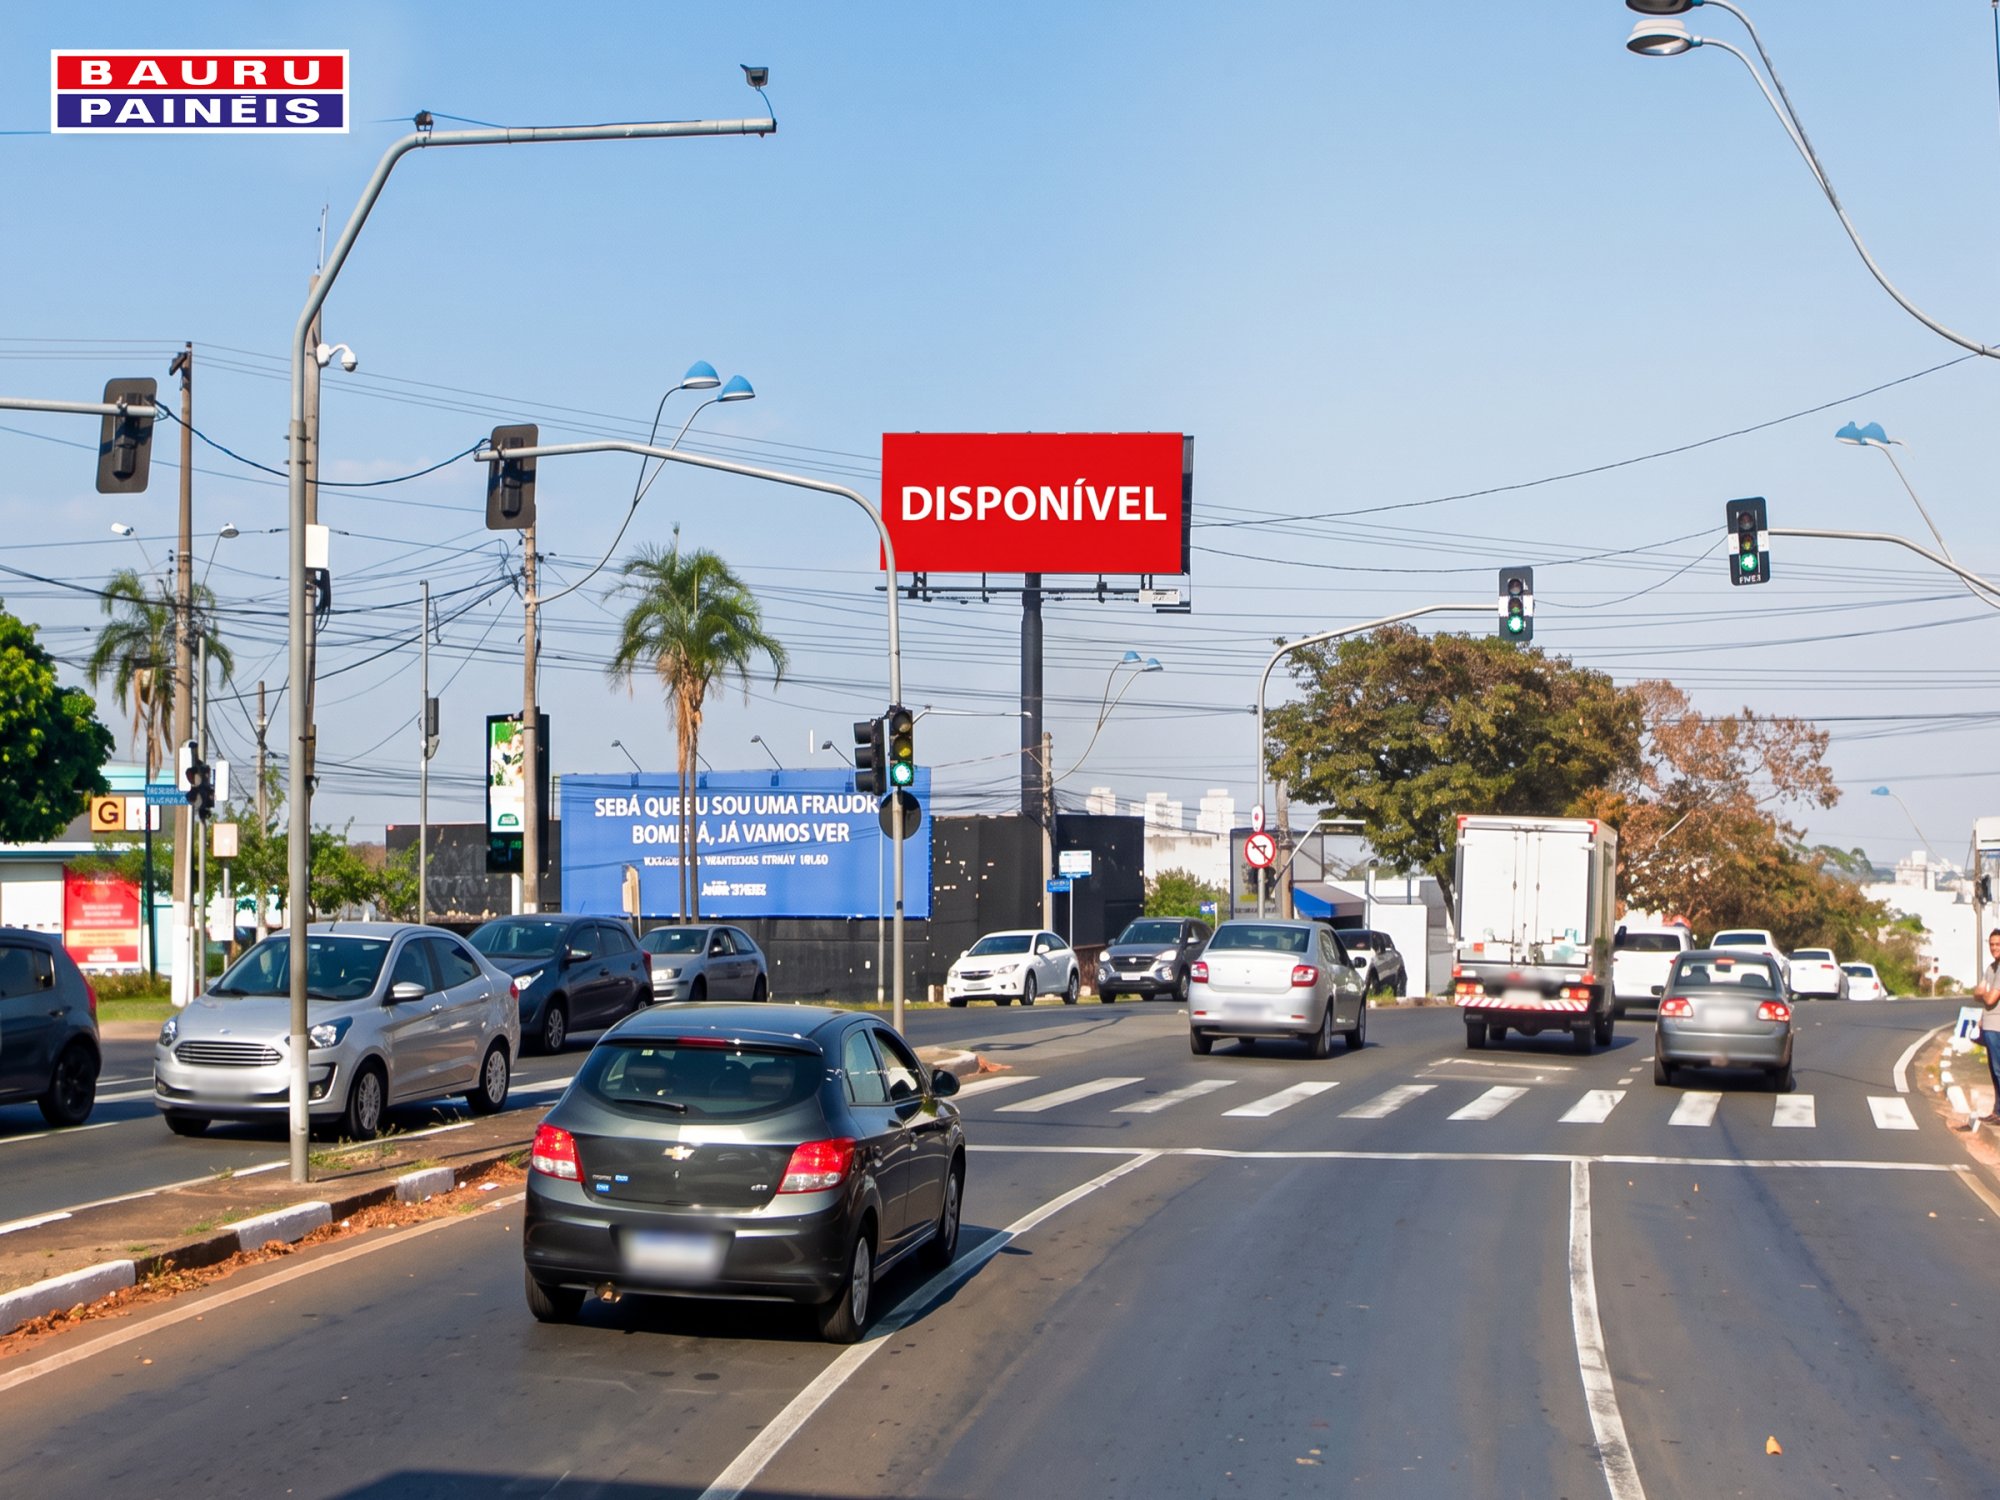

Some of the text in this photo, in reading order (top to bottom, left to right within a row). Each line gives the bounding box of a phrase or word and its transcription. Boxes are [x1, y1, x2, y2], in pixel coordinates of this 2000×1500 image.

[901, 478, 1167, 521] DISPONÍVEL
[98, 801, 119, 824] G
[712, 796, 751, 816] SOU
[754, 796, 799, 815] UMA
[717, 820, 740, 844] JÁ
[743, 823, 811, 843] VAMOS
[812, 823, 850, 843] VER
